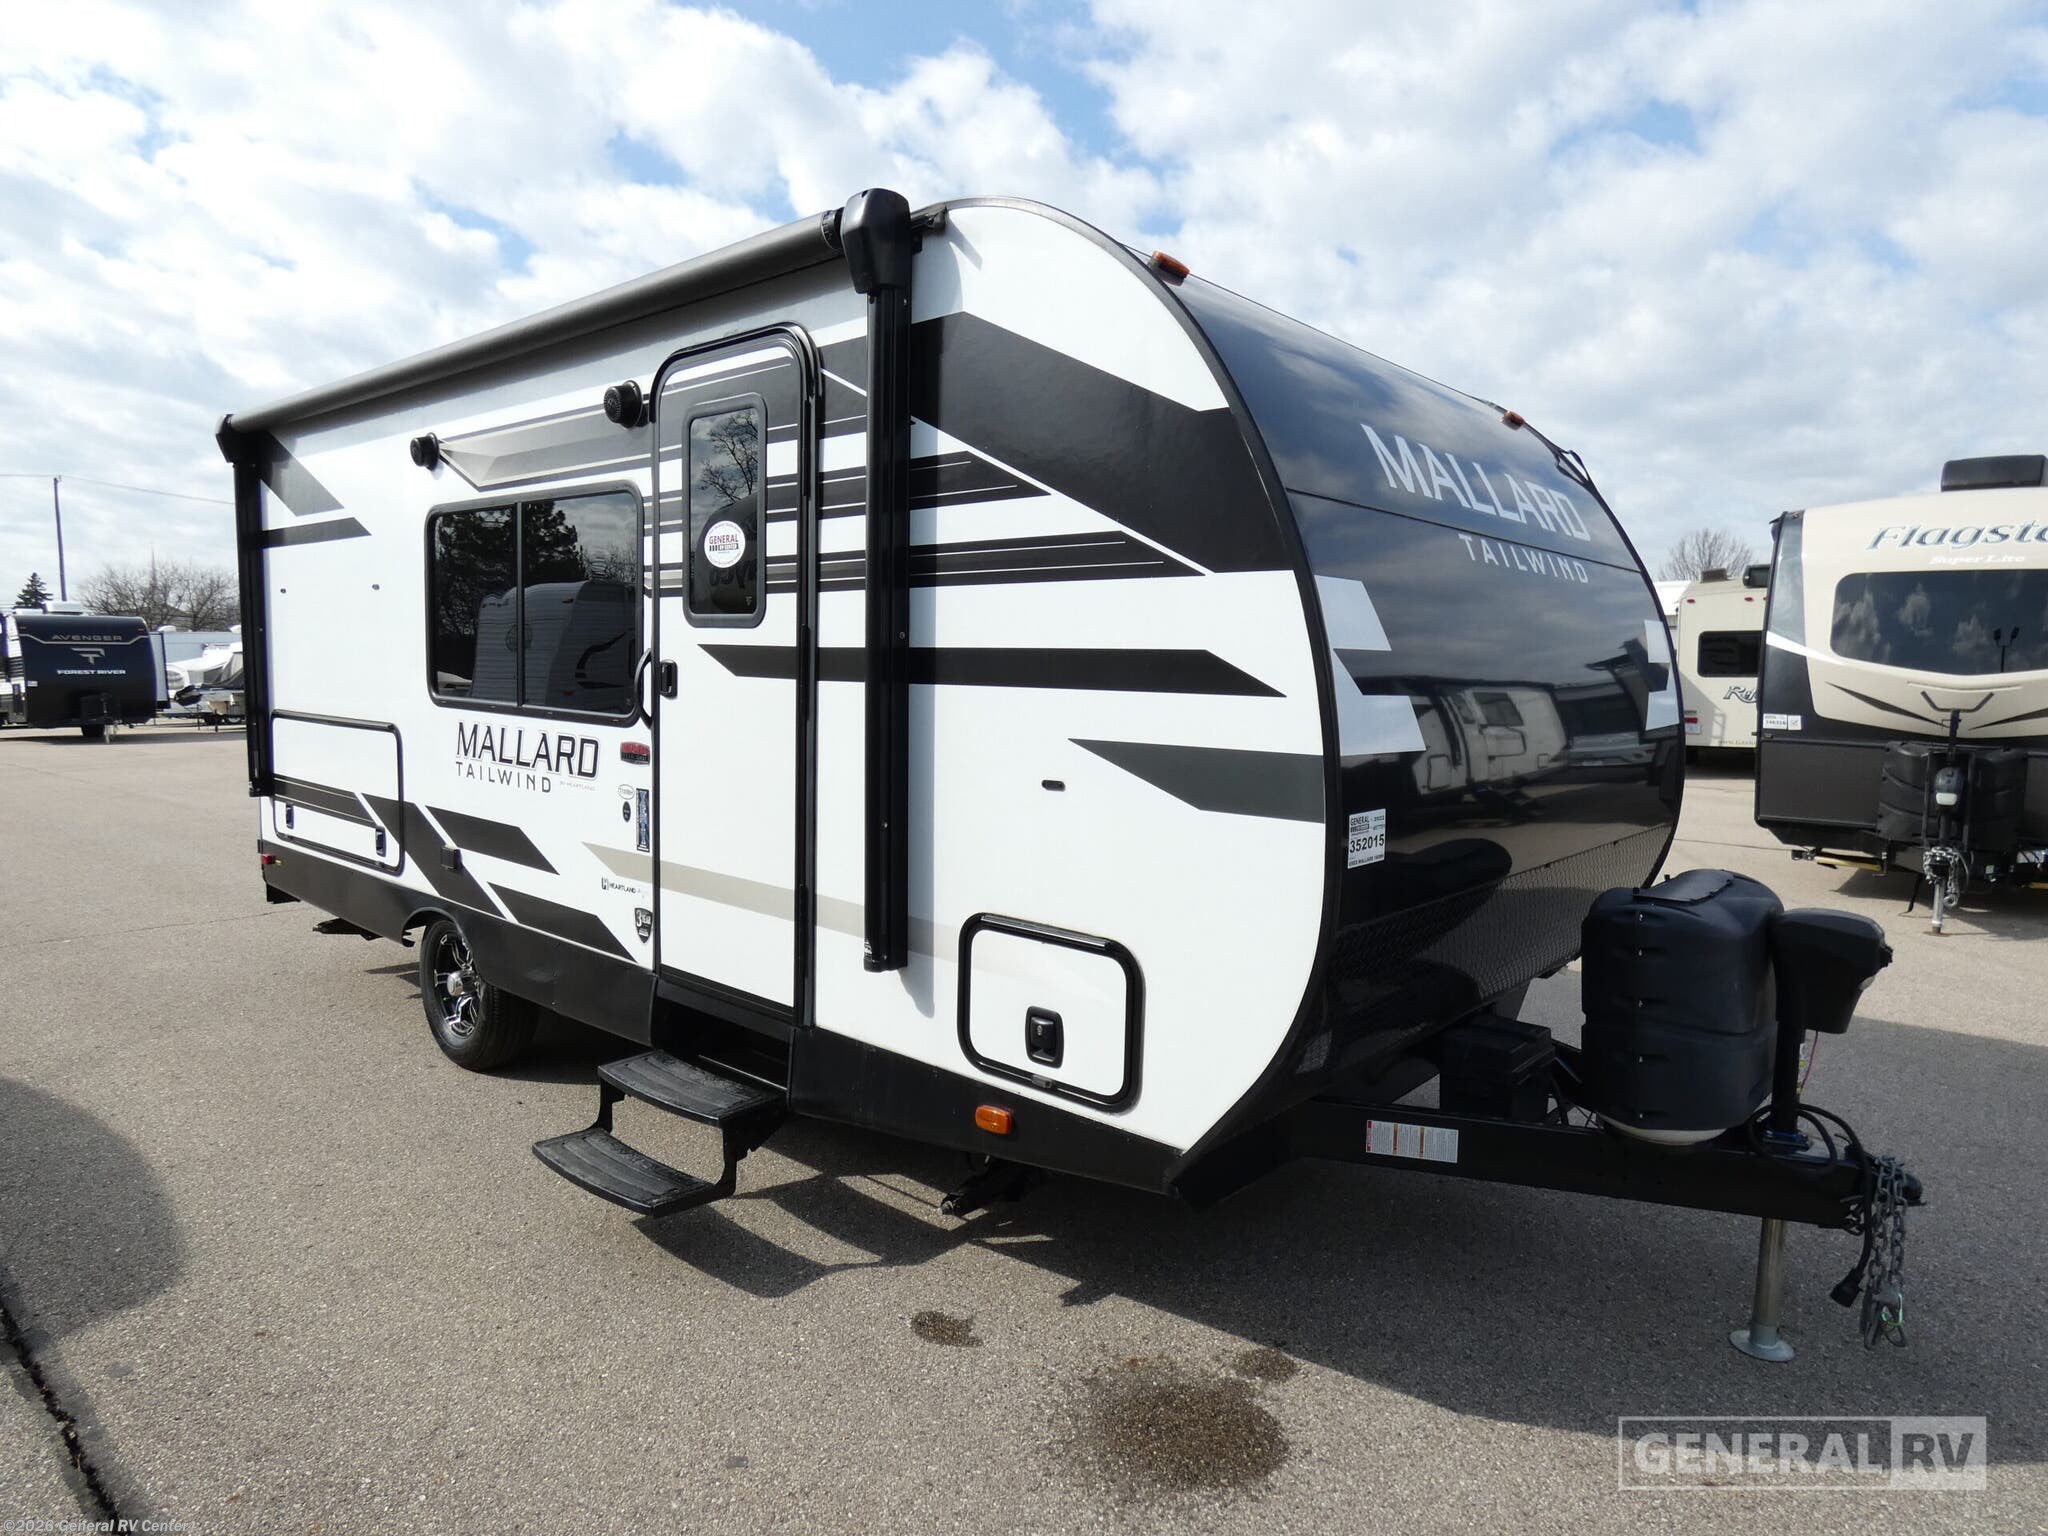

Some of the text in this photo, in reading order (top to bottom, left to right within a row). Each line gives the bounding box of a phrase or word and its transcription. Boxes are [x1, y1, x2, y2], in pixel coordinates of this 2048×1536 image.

[1360, 423, 1591, 541] MALLARD
[709, 534, 739, 544] GENERAL
[1457, 533, 1589, 584] TAILWIND
[456, 721, 599, 779] MALLARD
[455, 761, 551, 793] TAILWIND
[1350, 816, 1369, 826] GENERAL
[1350, 834, 1384, 853] 352015
[609, 882, 637, 894] HEARTLAND
